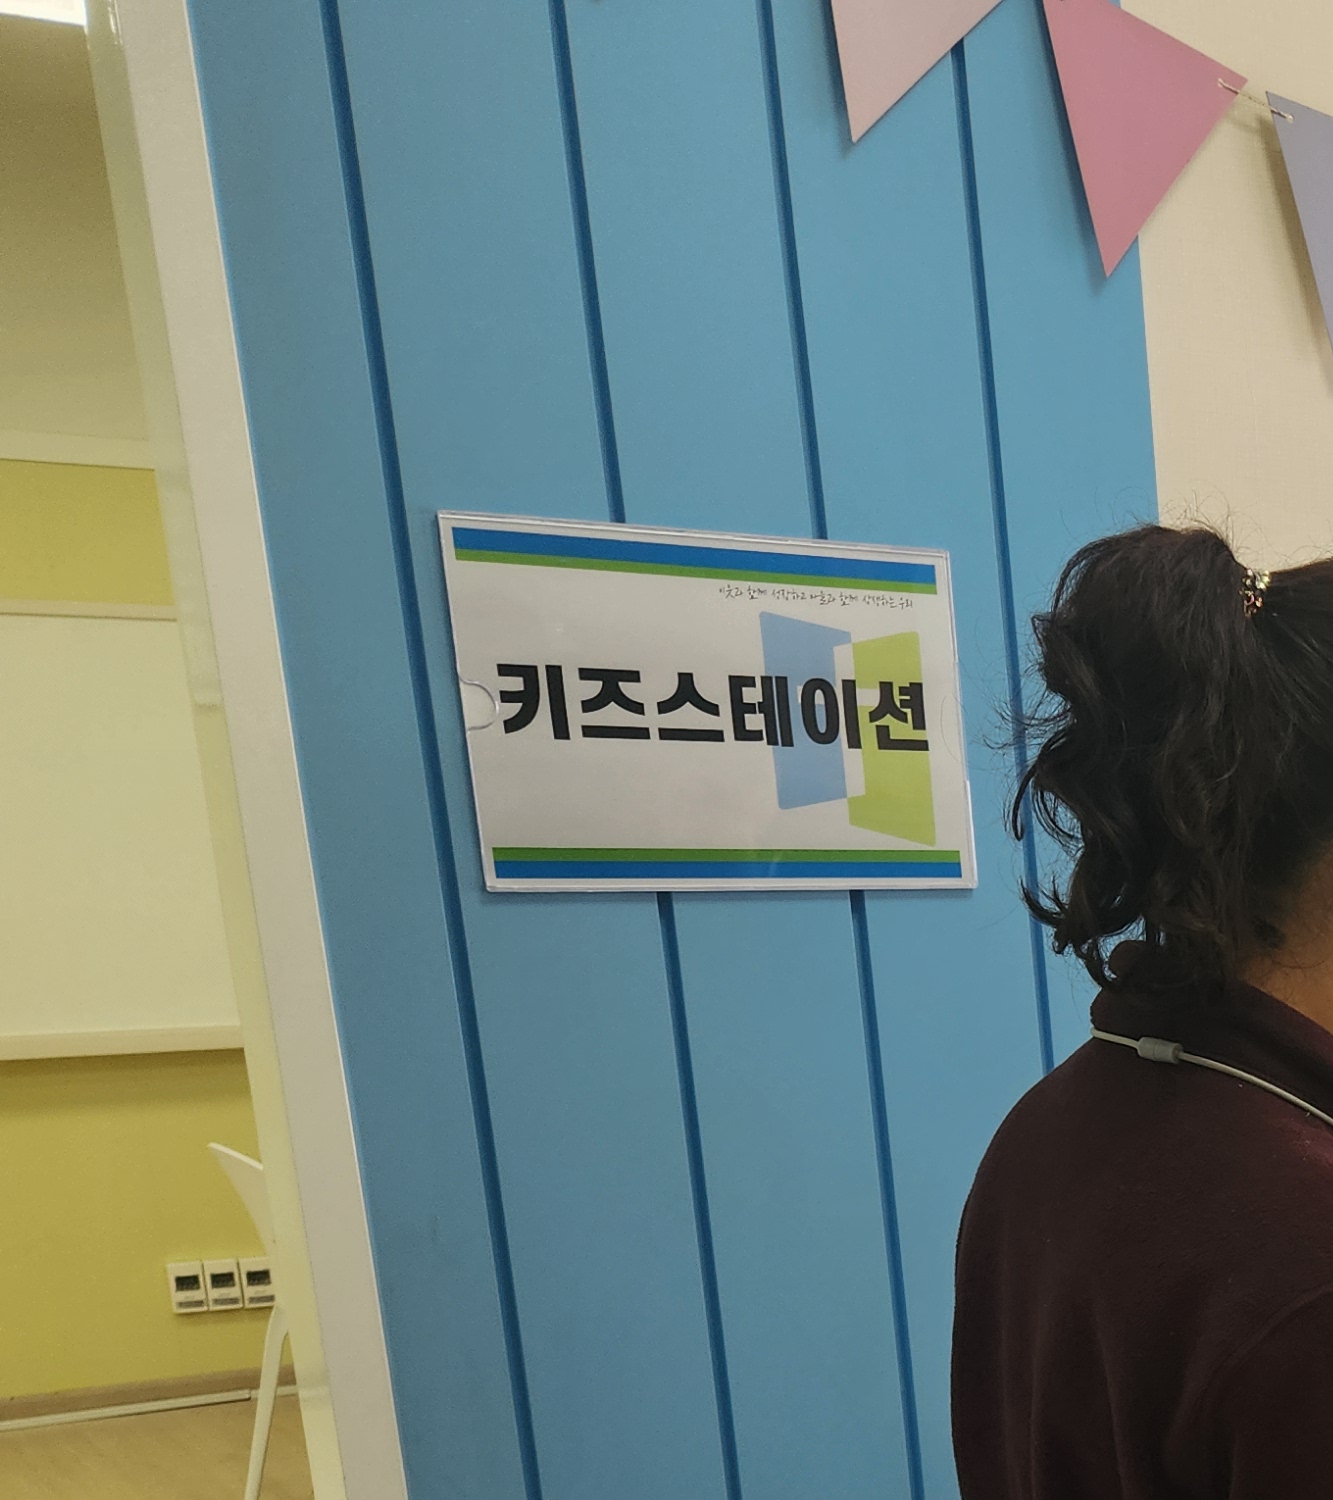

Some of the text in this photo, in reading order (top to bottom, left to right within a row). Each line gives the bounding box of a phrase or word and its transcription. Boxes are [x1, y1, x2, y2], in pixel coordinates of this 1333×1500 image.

[719, 585, 743, 599] 이웃과
[747, 585, 768, 599] 함께
[771, 588, 807, 600] 성장하고
[840, 593, 859, 606] 함께
[899, 598, 913, 609] 우리
[496, 663, 929, 752] 키즈스테이션
